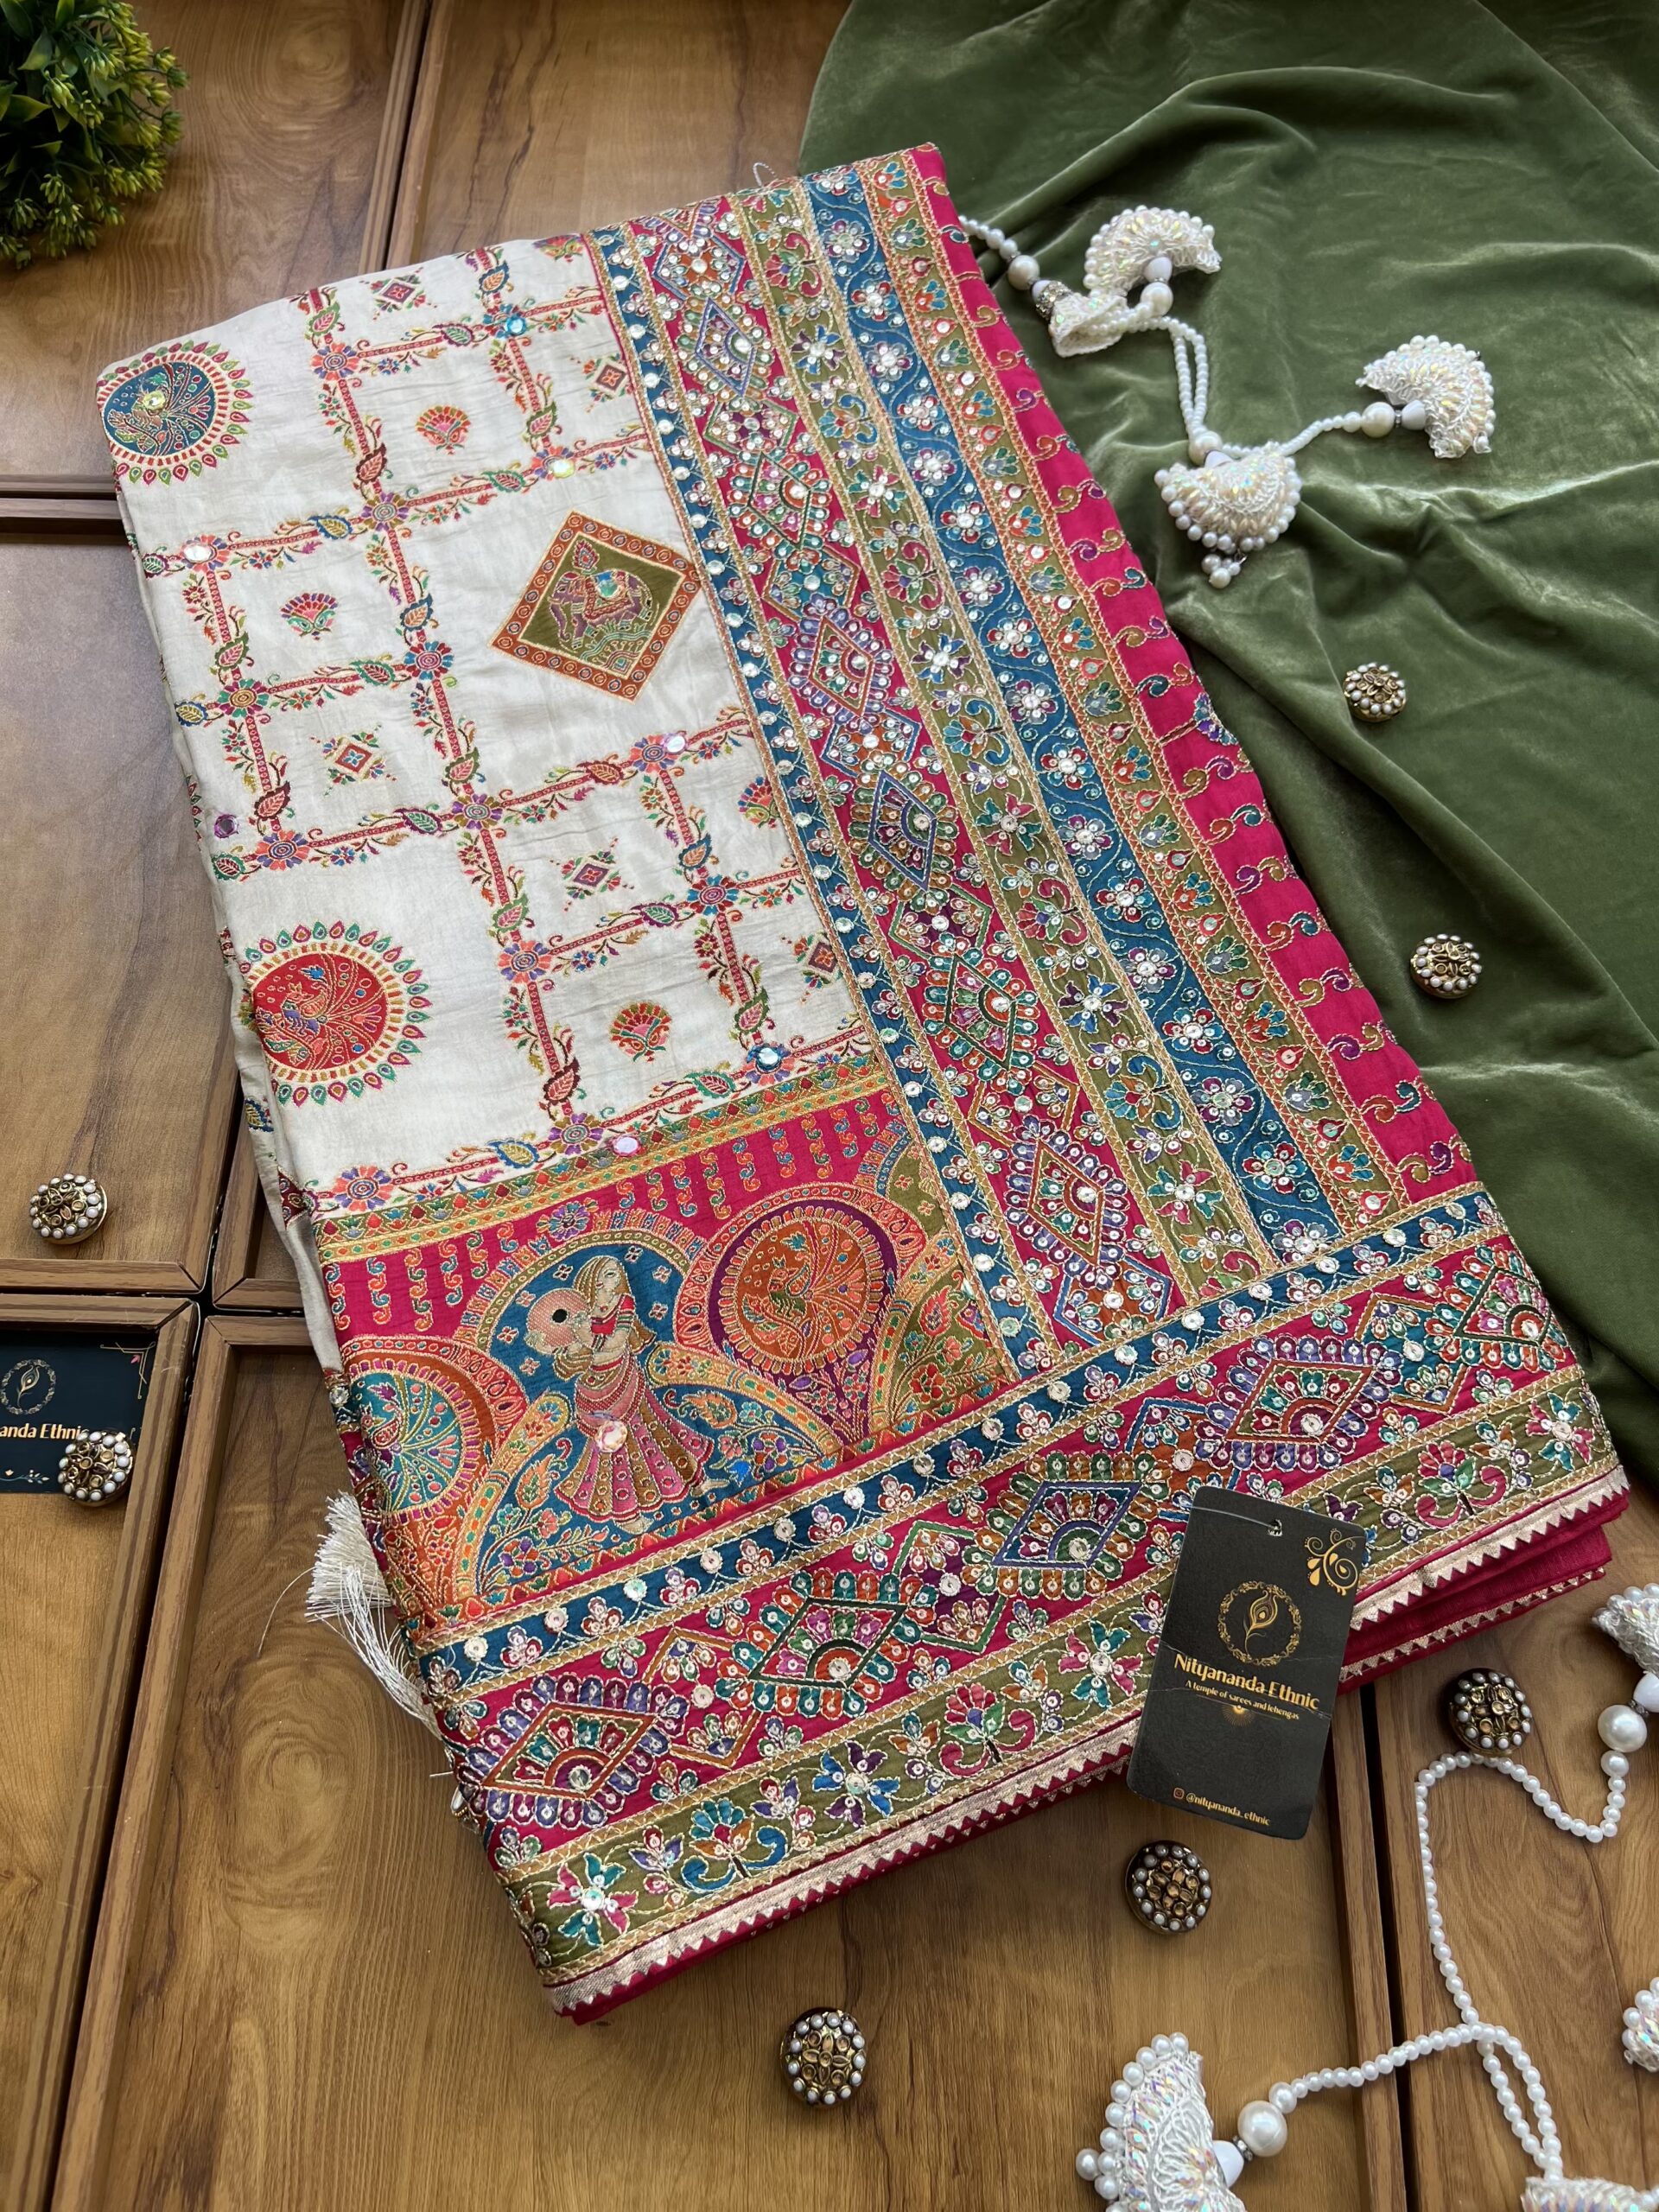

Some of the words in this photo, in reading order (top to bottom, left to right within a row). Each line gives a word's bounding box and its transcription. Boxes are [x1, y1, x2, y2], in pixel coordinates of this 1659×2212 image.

[40, 1423, 89, 1440] Ethni
[1174, 1653, 1265, 1694] Nityananda
[1268, 1681, 1320, 1710] Ethnic
[1185, 1680, 1192, 1688] A
[1192, 1681, 1218, 1697] temple
[1219, 1690, 1228, 1699] of
[1229, 1694, 1253, 1706] sarees
[1253, 1700, 1268, 1711] and
[1268, 1704, 1300, 1720] lehengas
